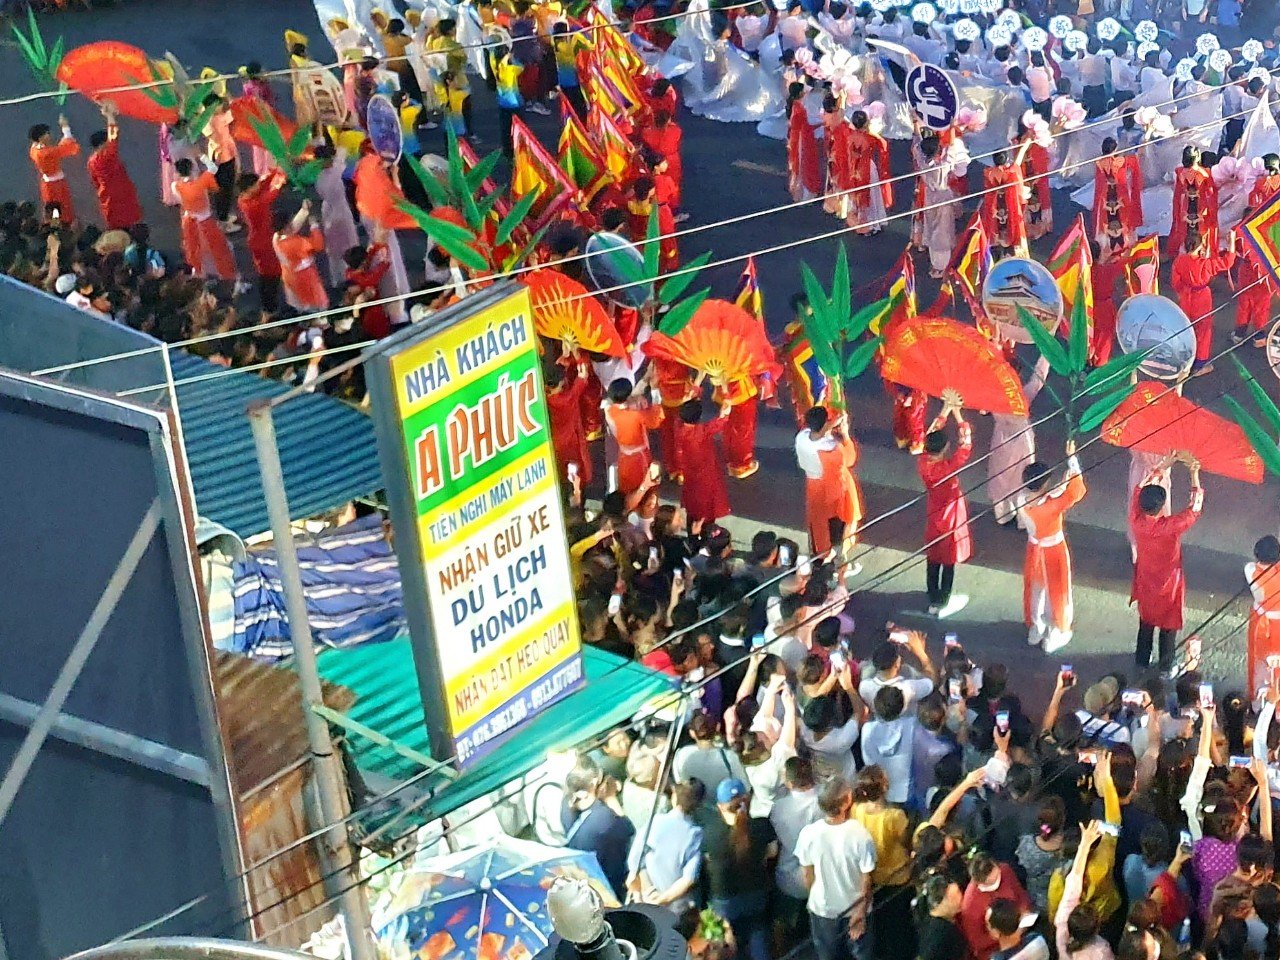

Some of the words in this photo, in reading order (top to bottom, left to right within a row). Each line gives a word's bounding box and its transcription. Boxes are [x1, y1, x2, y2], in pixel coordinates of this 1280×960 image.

[405, 350, 451, 403] NHÀ
[455, 314, 527, 375] KHÁCH
[416, 427, 442, 497] A
[447, 371, 538, 477] PHÚC
[459, 493, 487, 526] NGHI
[489, 477, 514, 508] MÁY
[516, 457, 547, 490] LẠNH
[438, 543, 490, 594] NHẬN
[493, 515, 523, 559] GIỮ
[527, 504, 550, 539] XE
[450, 584, 485, 627] DU
[492, 544, 548, 600] LỊCH
[469, 587, 544, 653] HONDA
[516, 639, 540, 673] HEO
[543, 617, 571, 656] QUAY
